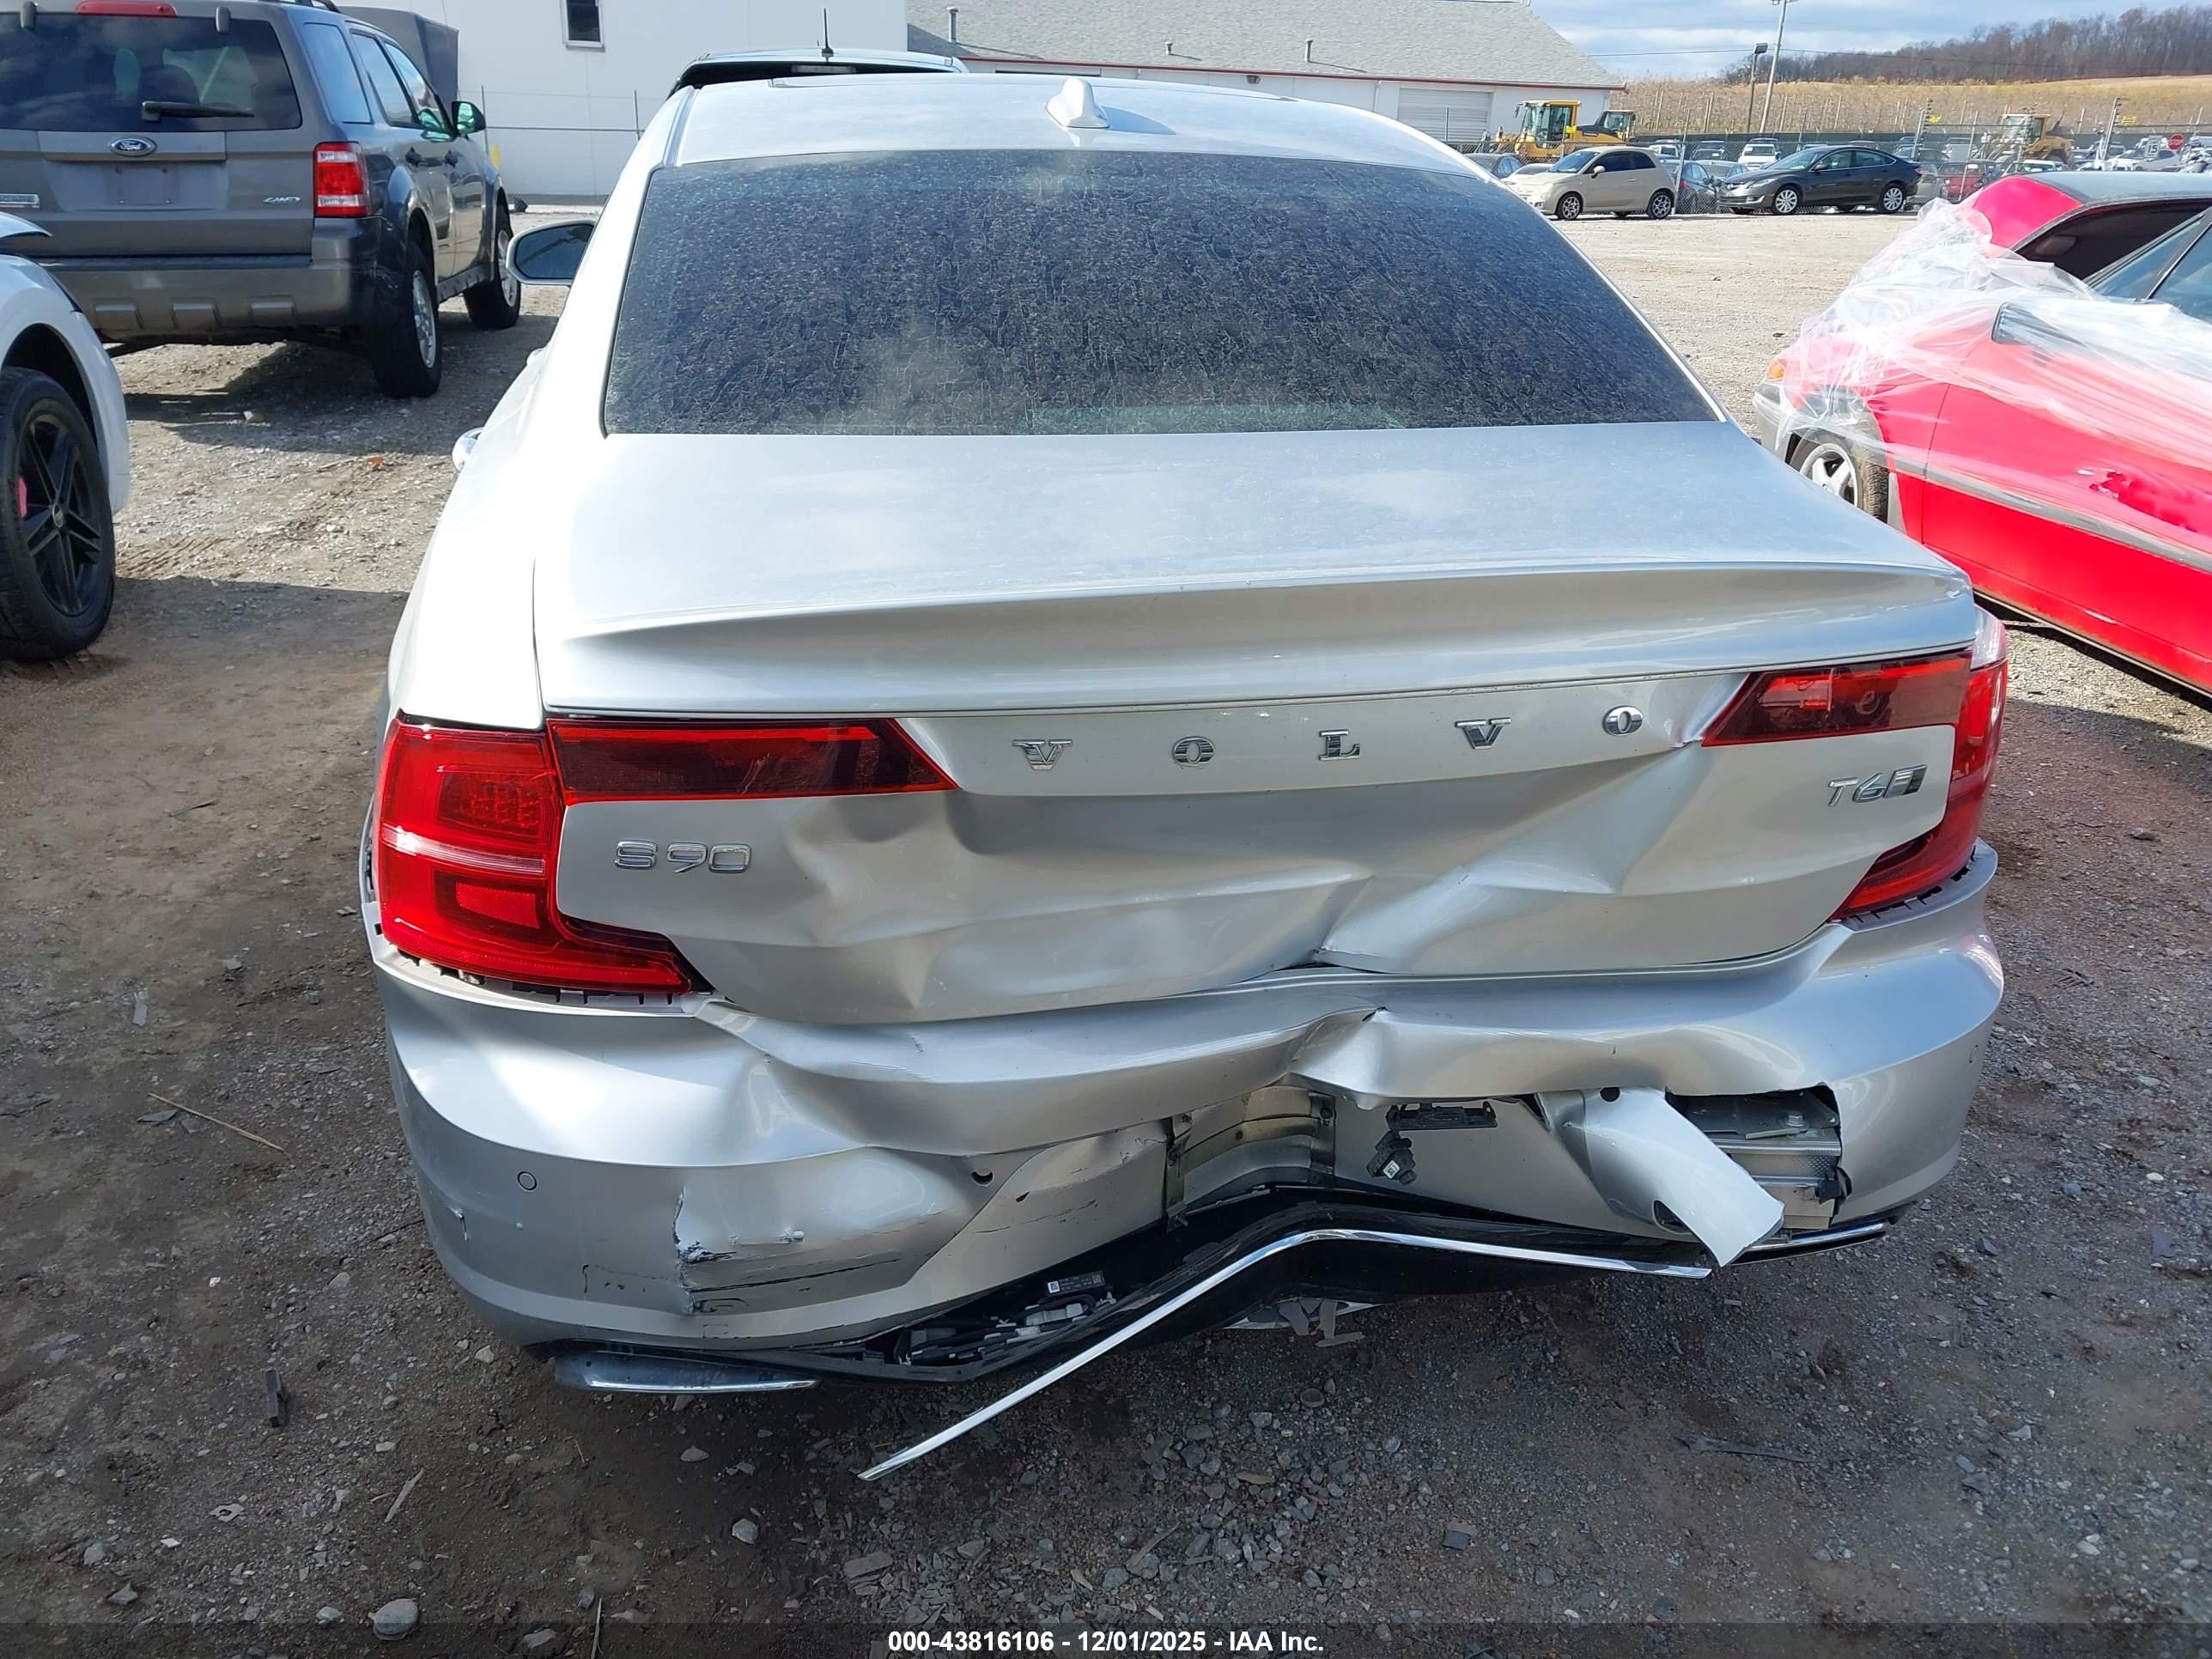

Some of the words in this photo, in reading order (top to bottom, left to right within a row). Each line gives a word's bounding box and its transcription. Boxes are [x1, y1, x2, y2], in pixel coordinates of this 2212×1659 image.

[2147, 144, 2159, 154] 15
[1012, 704, 1644, 771] VOLVO
[614, 840, 752, 874] S90
